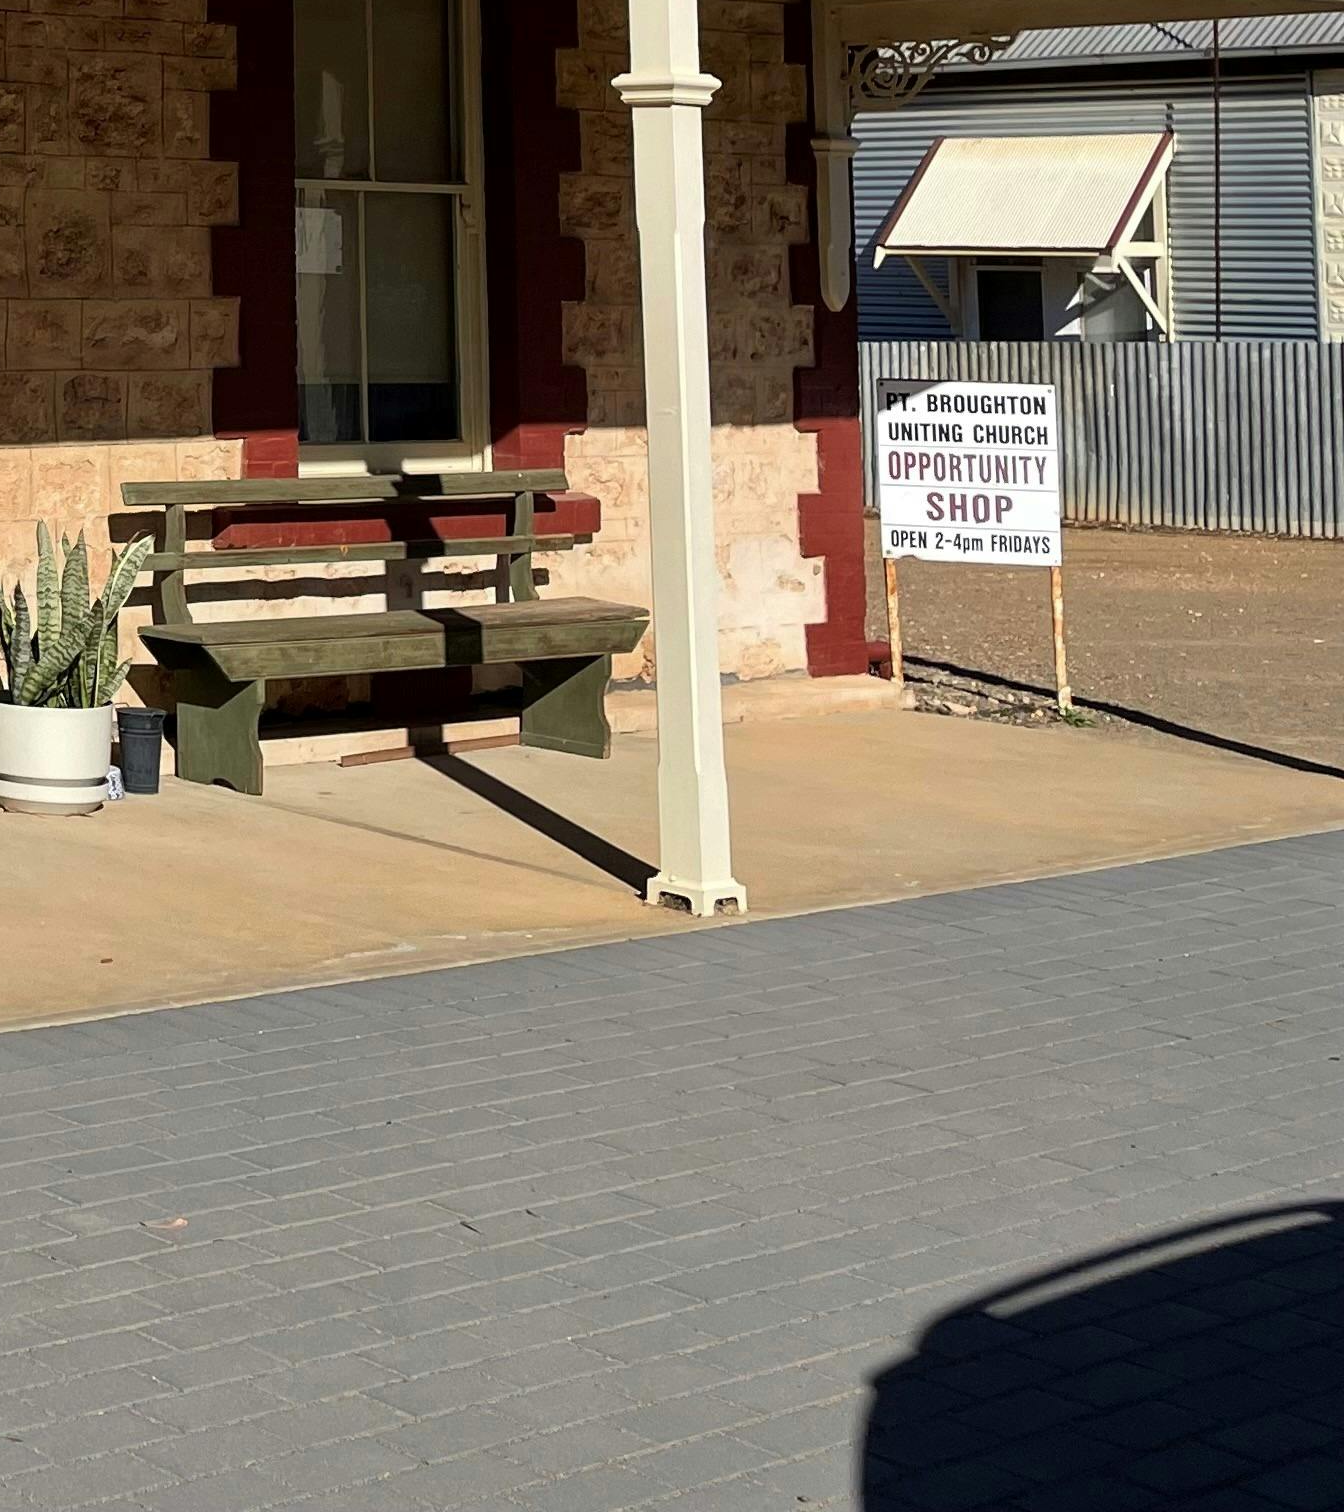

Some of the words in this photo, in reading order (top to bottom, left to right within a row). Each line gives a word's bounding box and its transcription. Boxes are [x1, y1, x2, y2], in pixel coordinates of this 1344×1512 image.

[886, 392, 916, 412] PT.
[927, 394, 1047, 415] BROUGHTON
[888, 422, 963, 443] UNITING
[973, 424, 1048, 445] CHURCH
[888, 451, 1047, 485] OPPORTUNITY
[926, 492, 1014, 524] SHOP
[891, 530, 927, 549] OPEN
[935, 532, 983, 554] 2-4pm
[991, 535, 1050, 554] FRIDAYS
